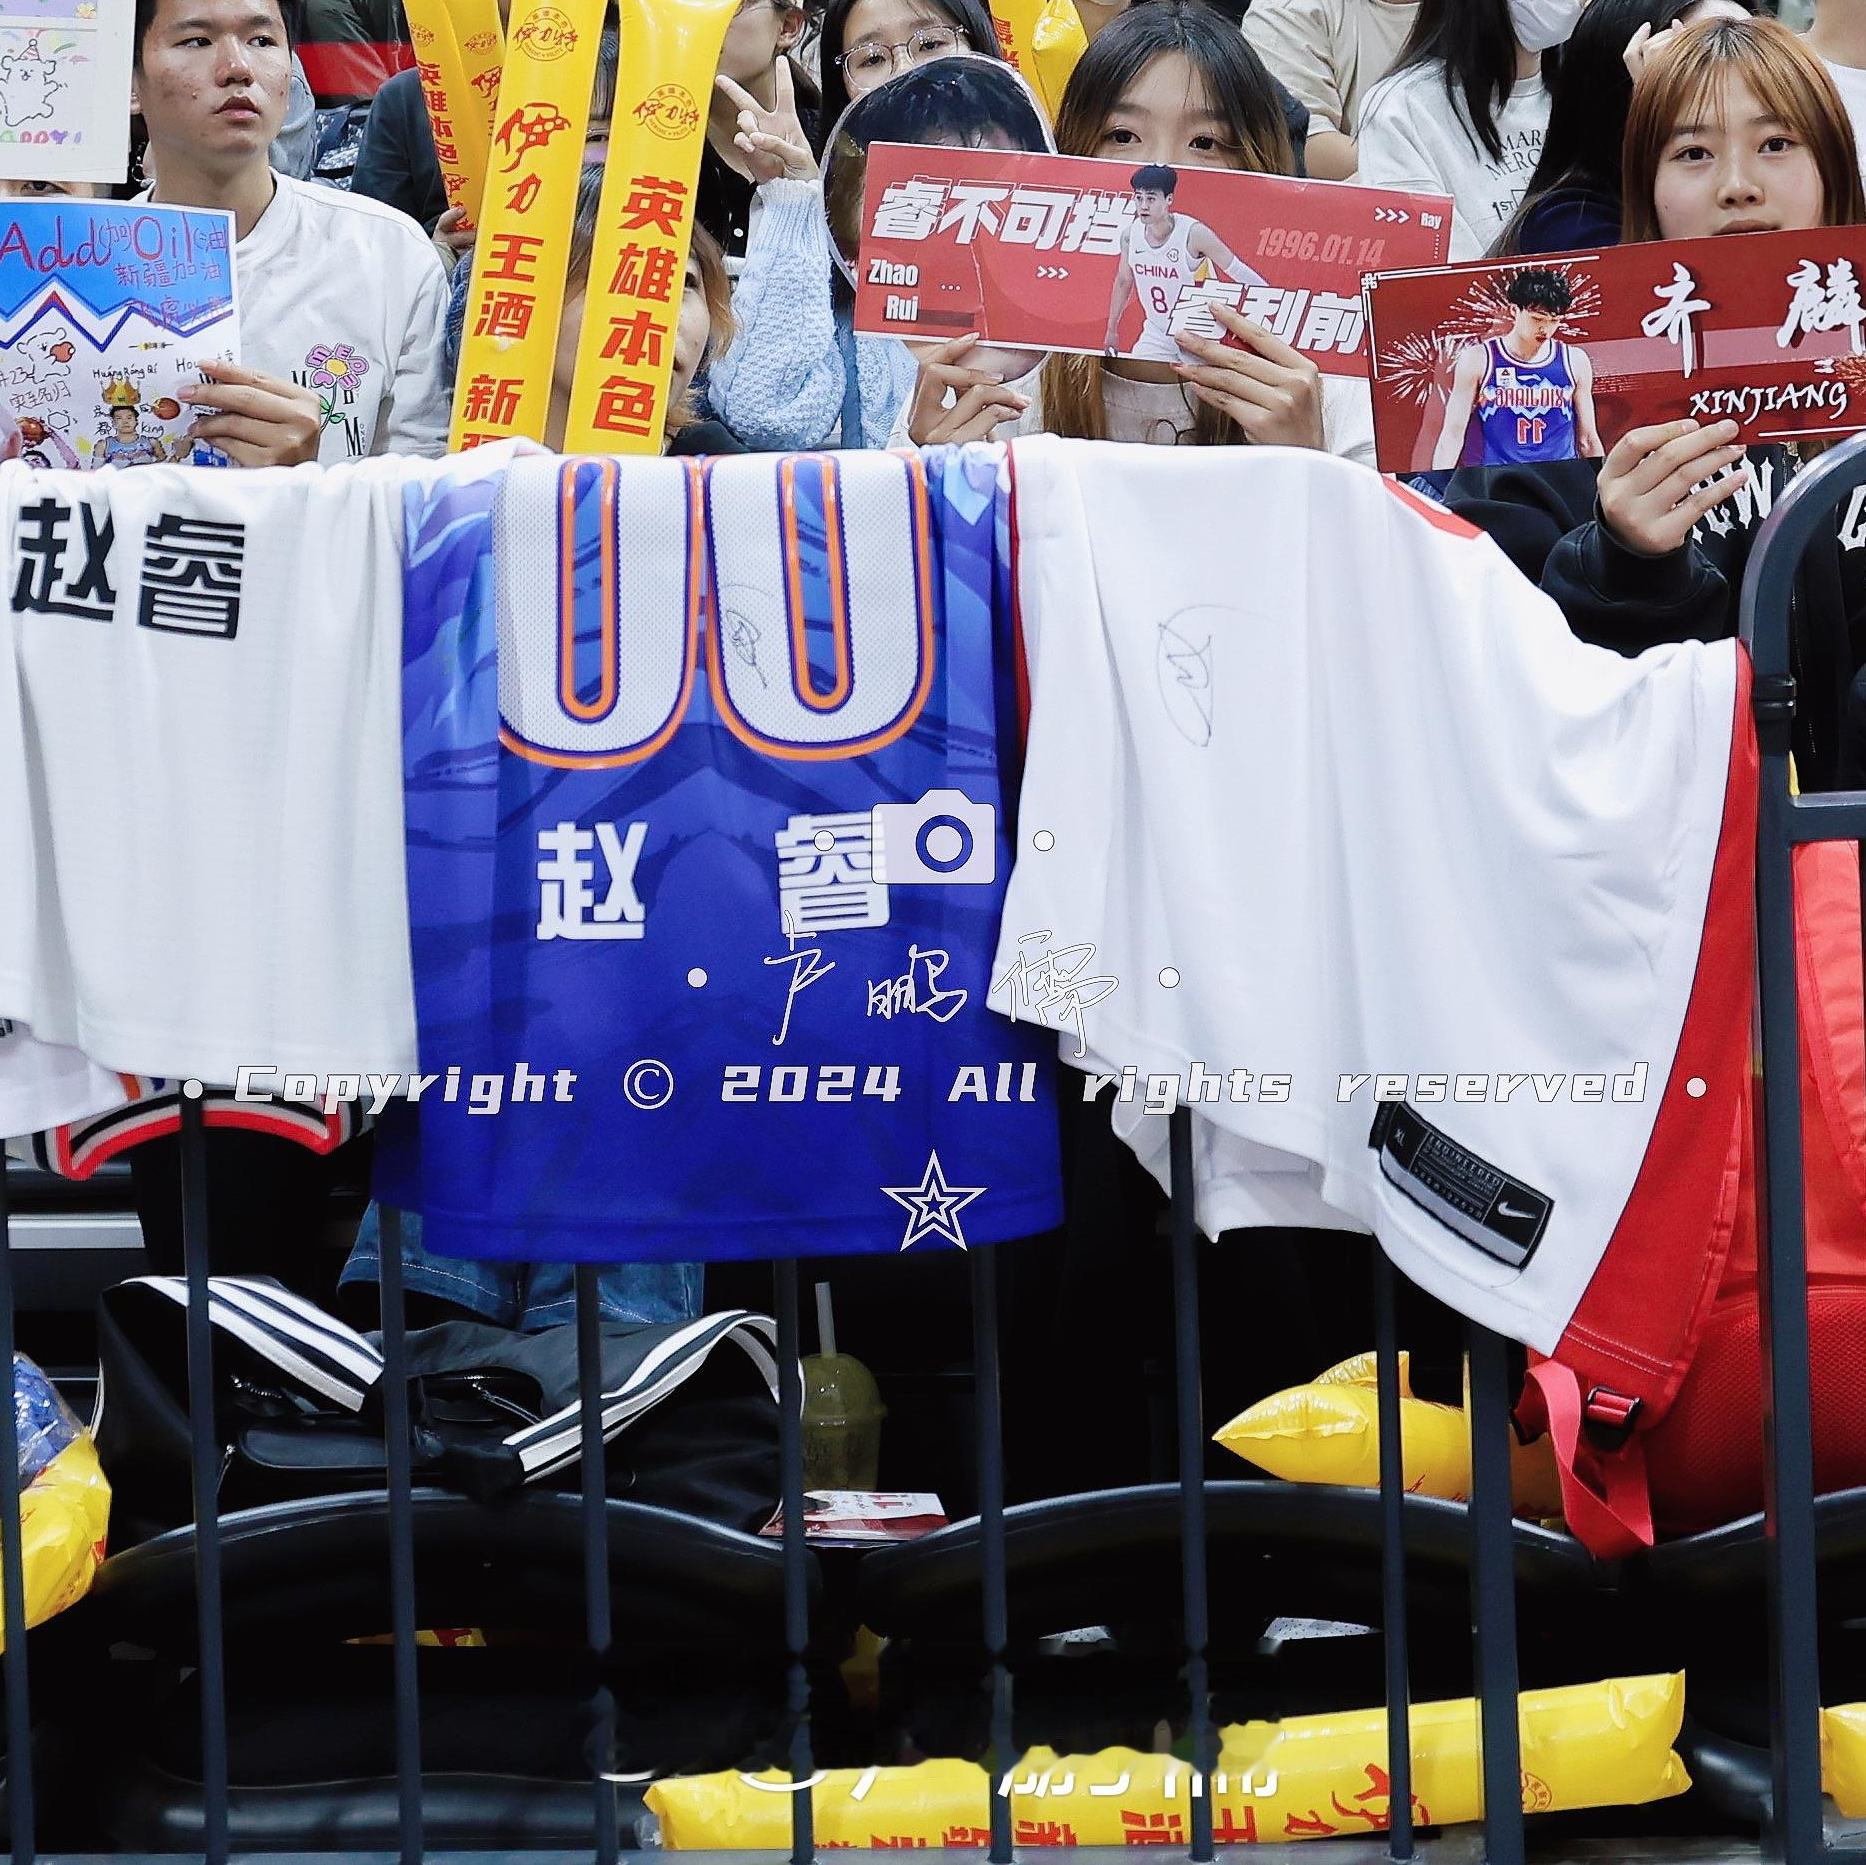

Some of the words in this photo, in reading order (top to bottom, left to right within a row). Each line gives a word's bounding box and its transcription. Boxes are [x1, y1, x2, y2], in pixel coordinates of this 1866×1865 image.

[133, 211, 193, 264] Oil
[870, 174, 1136, 257] 睿不可挡
[869, 258, 919, 287] Zhao
[1134, 262, 1180, 280] CHINA
[1255, 226, 1385, 267] 1996.01.14
[591, 174, 689, 438] 英雄本色
[885, 293, 919, 322] Rui
[1149, 285, 1169, 314] 8
[1166, 277, 1368, 356] 睿利前
[1689, 377, 1851, 421] XINJIANG
[8, 493, 249, 645] 赵睿
[493, 452, 937, 769] 00
[535, 811, 890, 943] 赵睿
